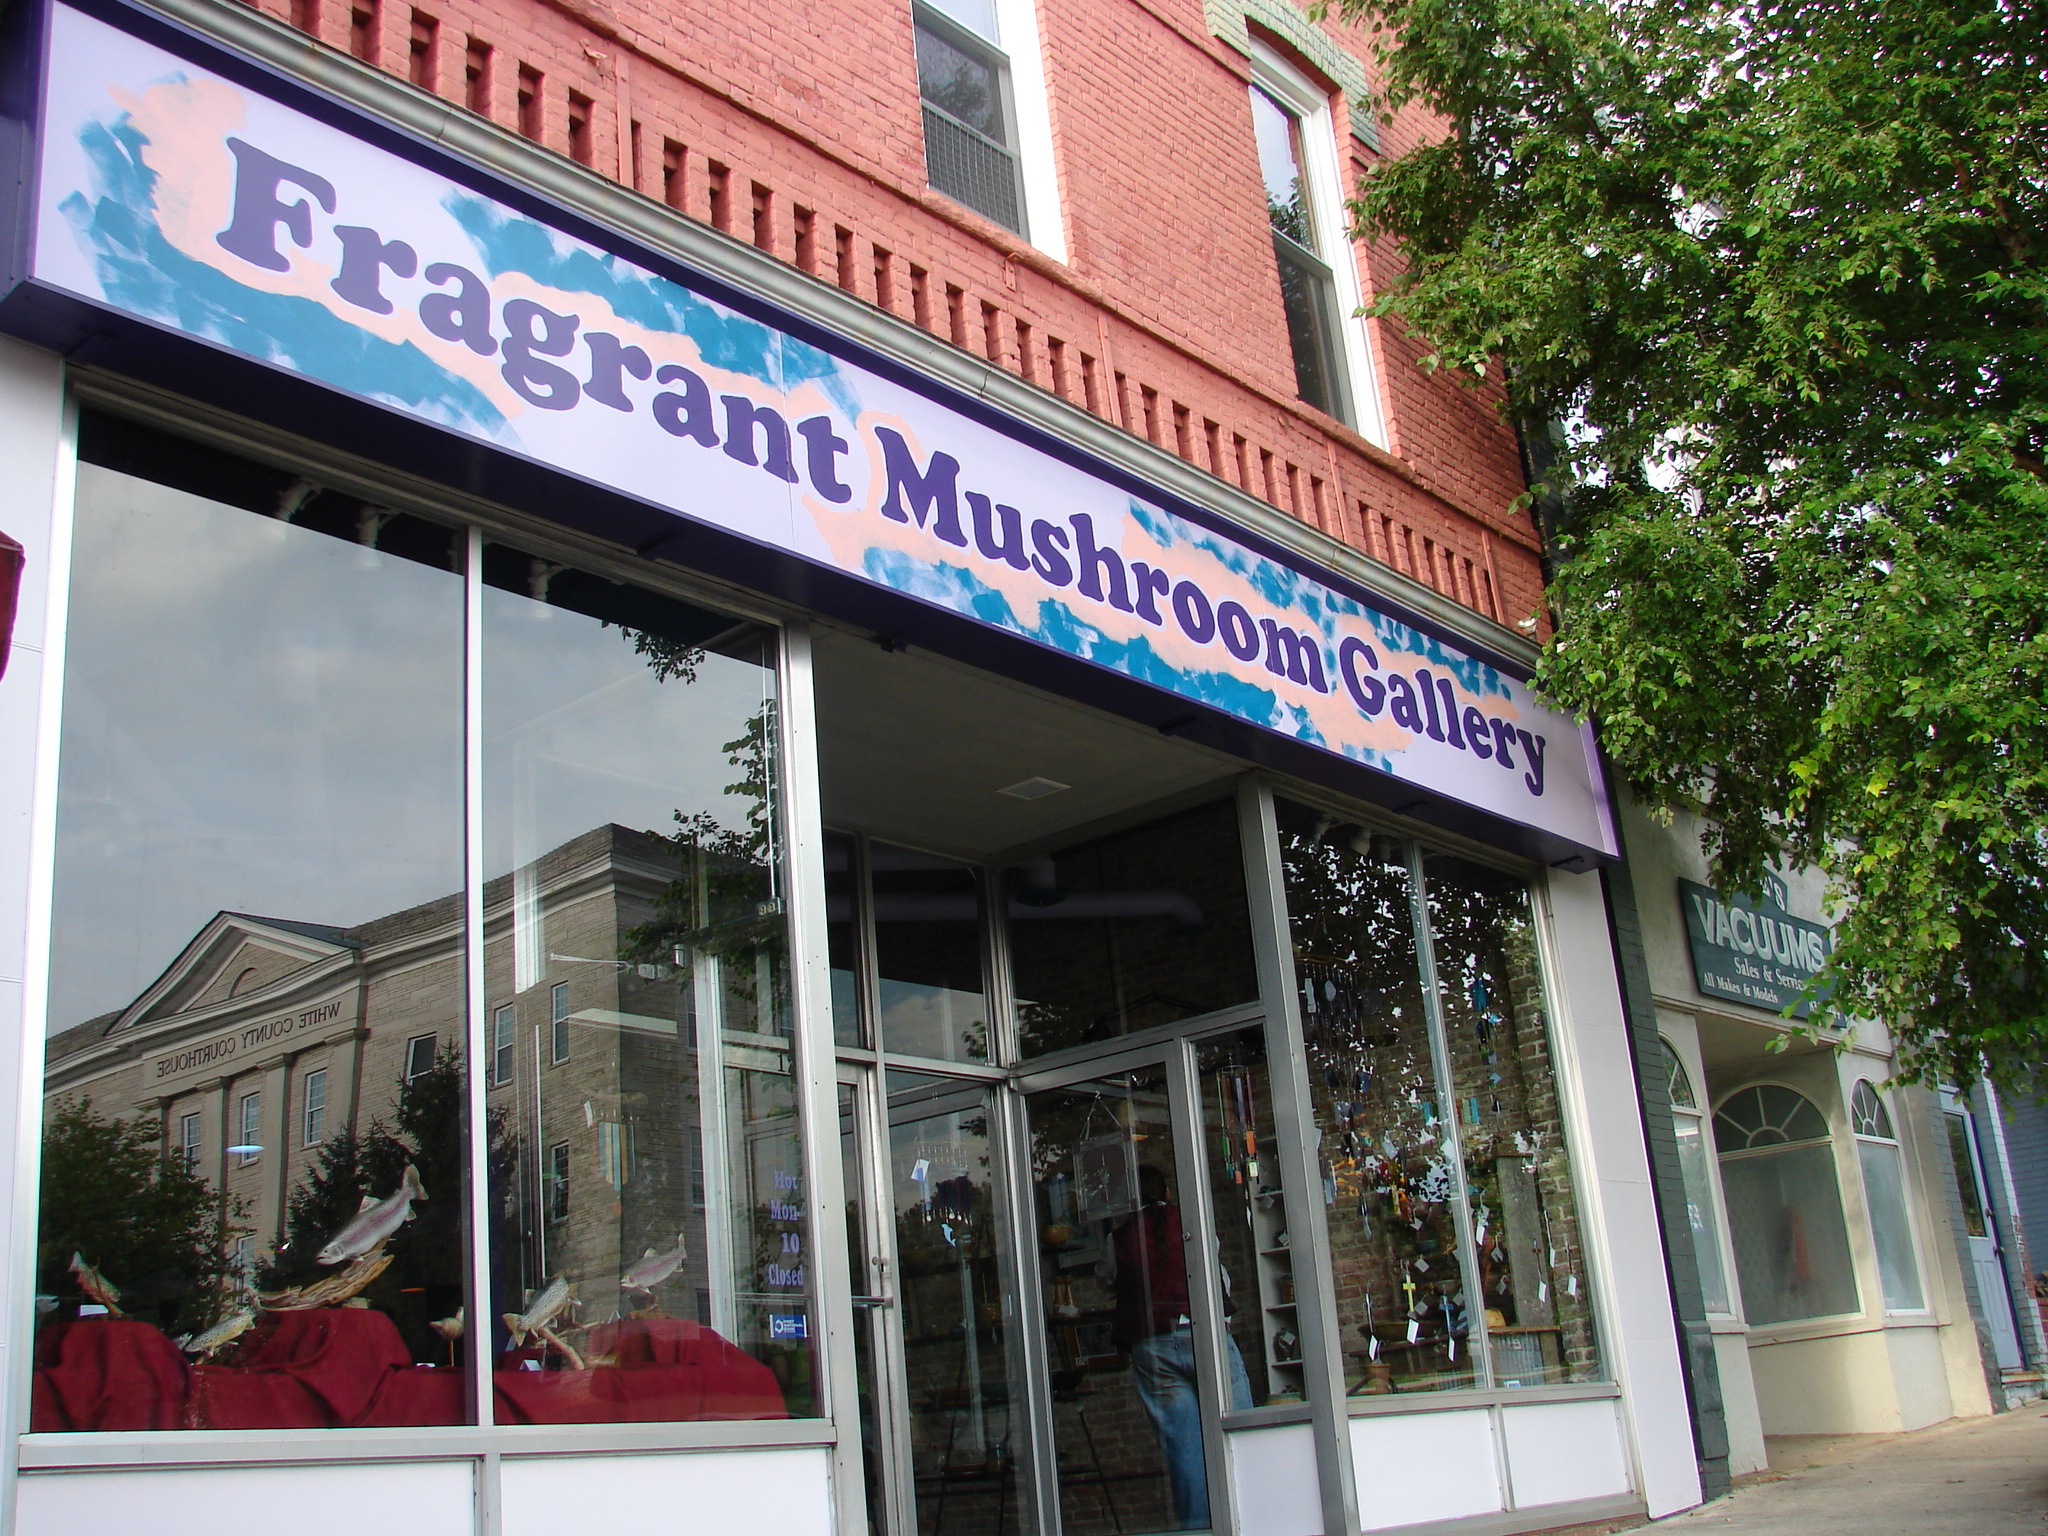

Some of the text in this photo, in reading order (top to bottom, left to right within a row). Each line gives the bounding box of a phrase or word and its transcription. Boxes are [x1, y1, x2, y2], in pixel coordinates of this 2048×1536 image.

[215, 136, 1546, 796] Fragrant Mushroom Gallery
[1691, 894, 1827, 974] VACUUMS
[1704, 972, 1779, 1005] All Makes & Models
[1734, 957, 1805, 991] Sales & Servic
[768, 1264, 804, 1286] Closed
